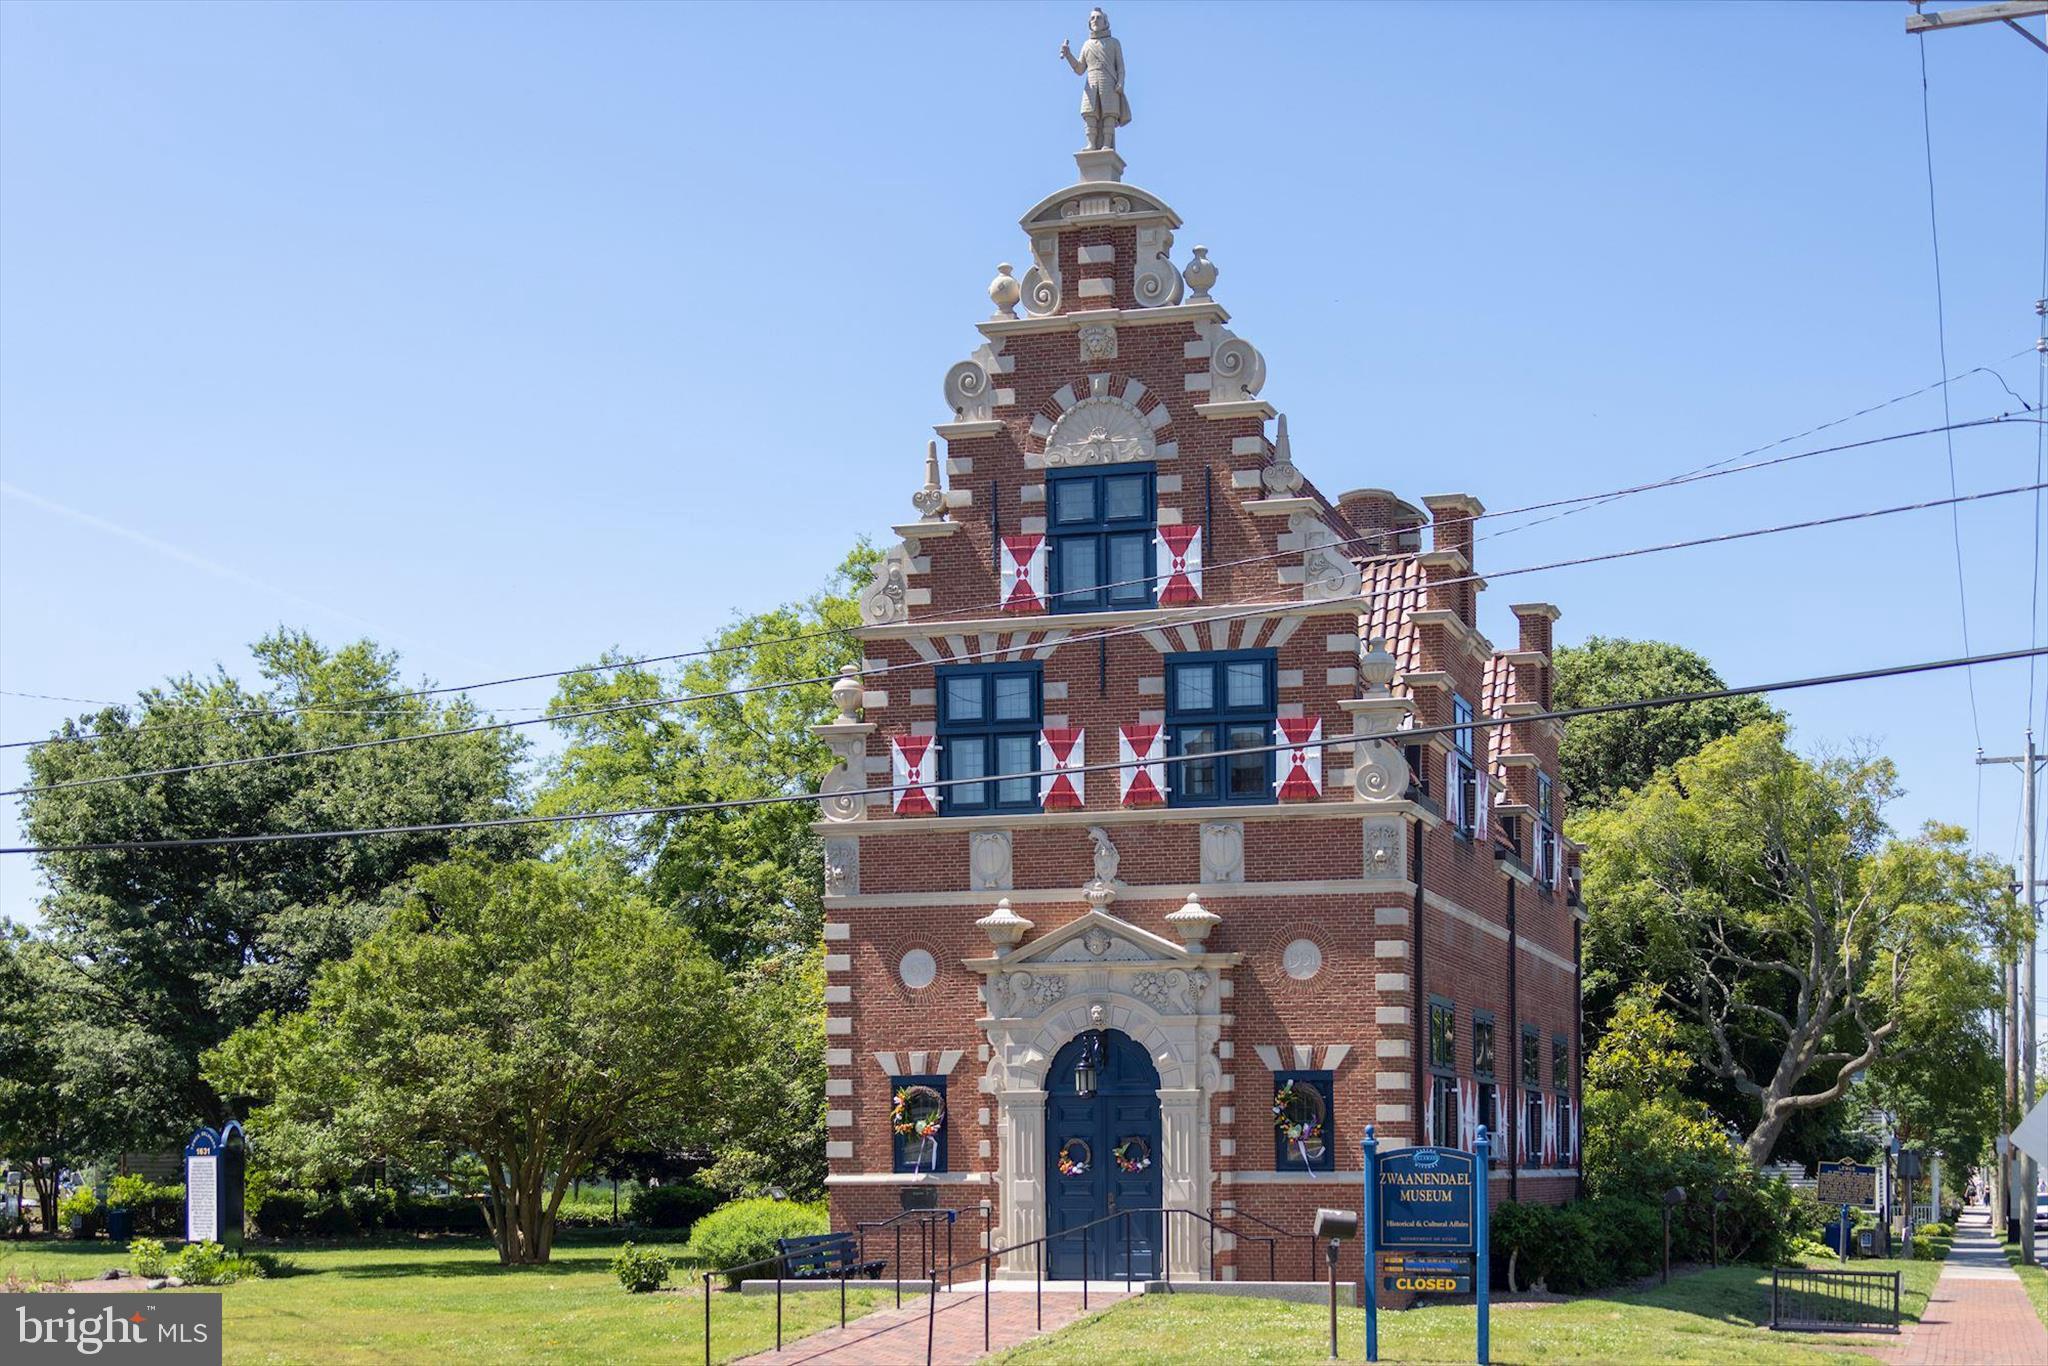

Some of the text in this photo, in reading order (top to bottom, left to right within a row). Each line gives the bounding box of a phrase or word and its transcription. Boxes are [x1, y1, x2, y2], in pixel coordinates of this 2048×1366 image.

[1379, 1172, 1472, 1185] ZWAANENDAEL
[1400, 1190, 1453, 1202] MUSEUM
[1386, 1220, 1415, 1228] Historical
[1423, 1220, 1448, 1228] Cultural
[1448, 1220, 1469, 1228] Affairs
[1396, 1278, 1457, 1291] CLOSED
